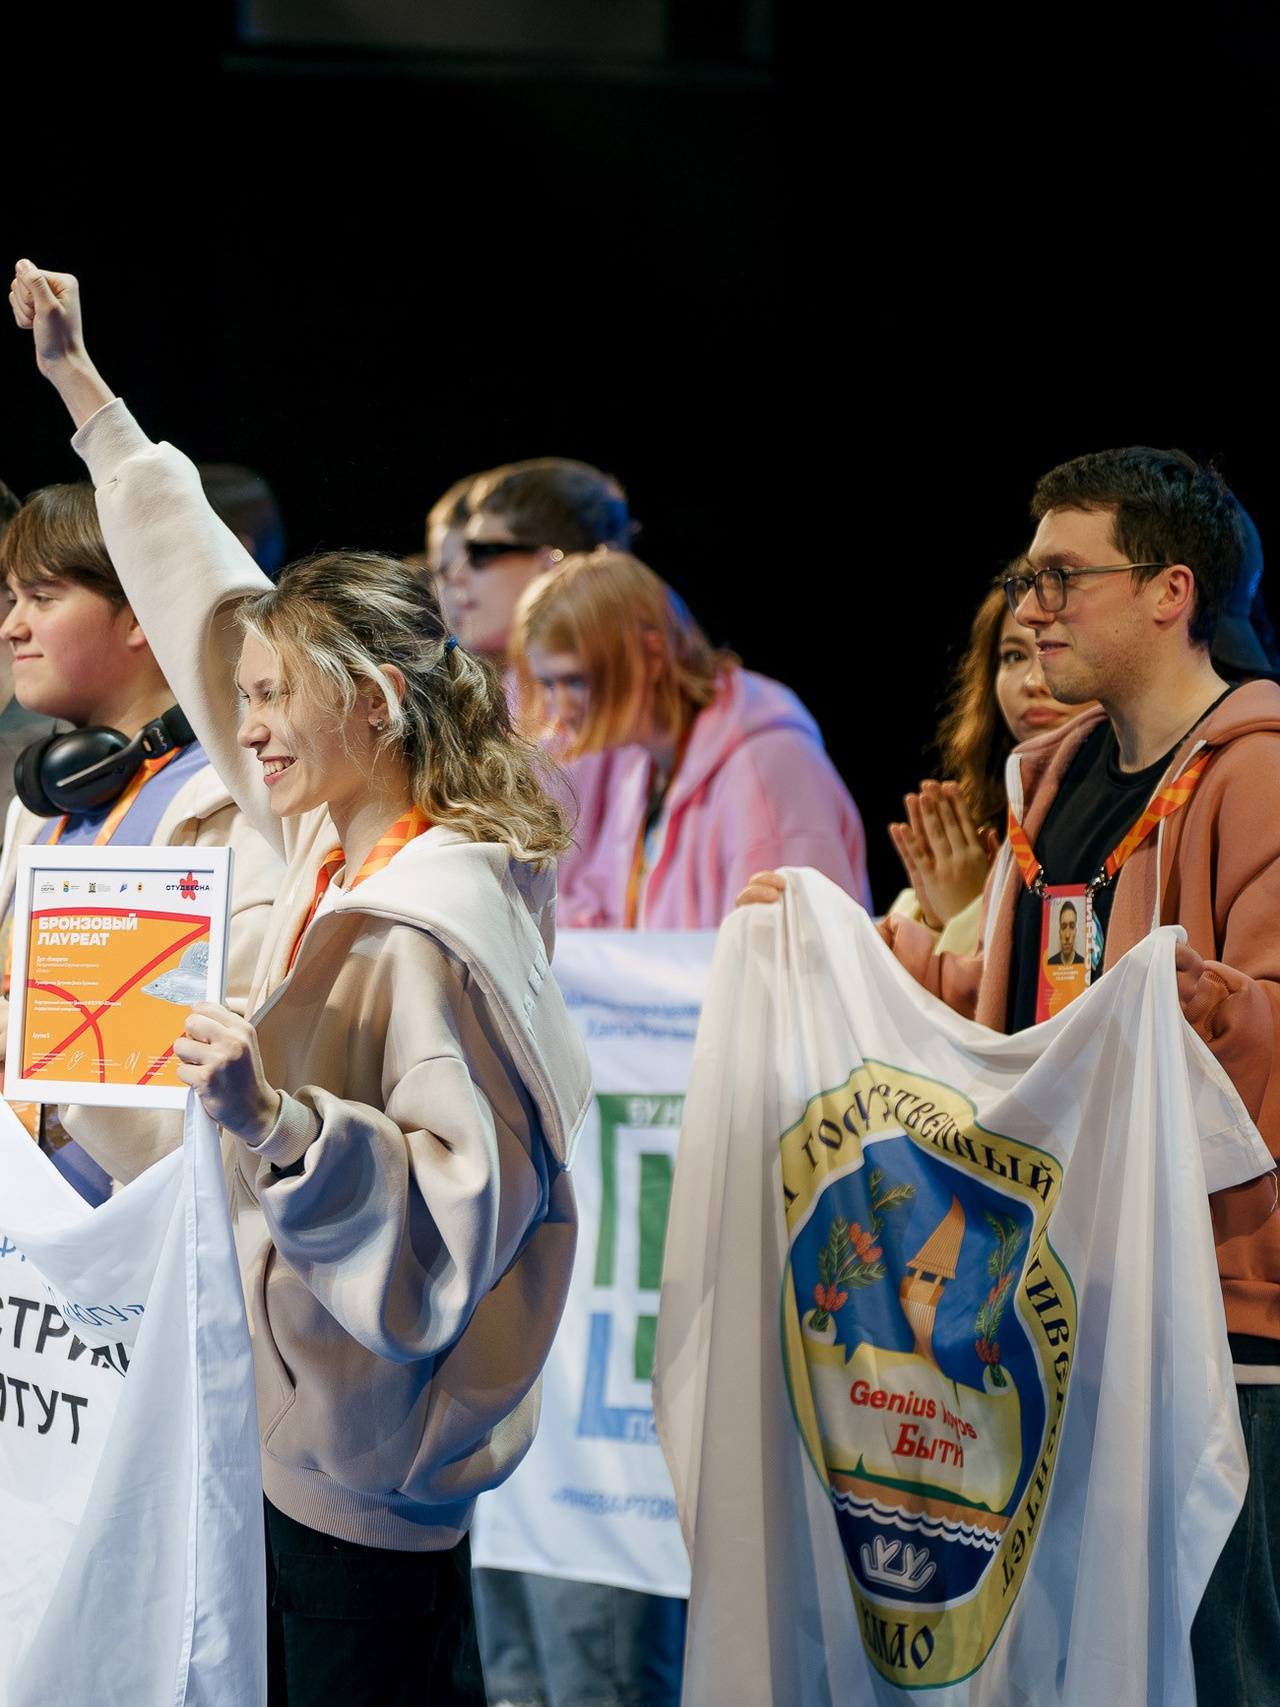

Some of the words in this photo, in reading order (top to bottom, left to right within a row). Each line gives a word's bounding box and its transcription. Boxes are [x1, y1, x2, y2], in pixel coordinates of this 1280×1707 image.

[38, 913, 138, 931] БРОНЗОВЫЙ
[37, 932, 110, 946] ЛАУРЕАТ
[849, 1379, 937, 1420] Genius
